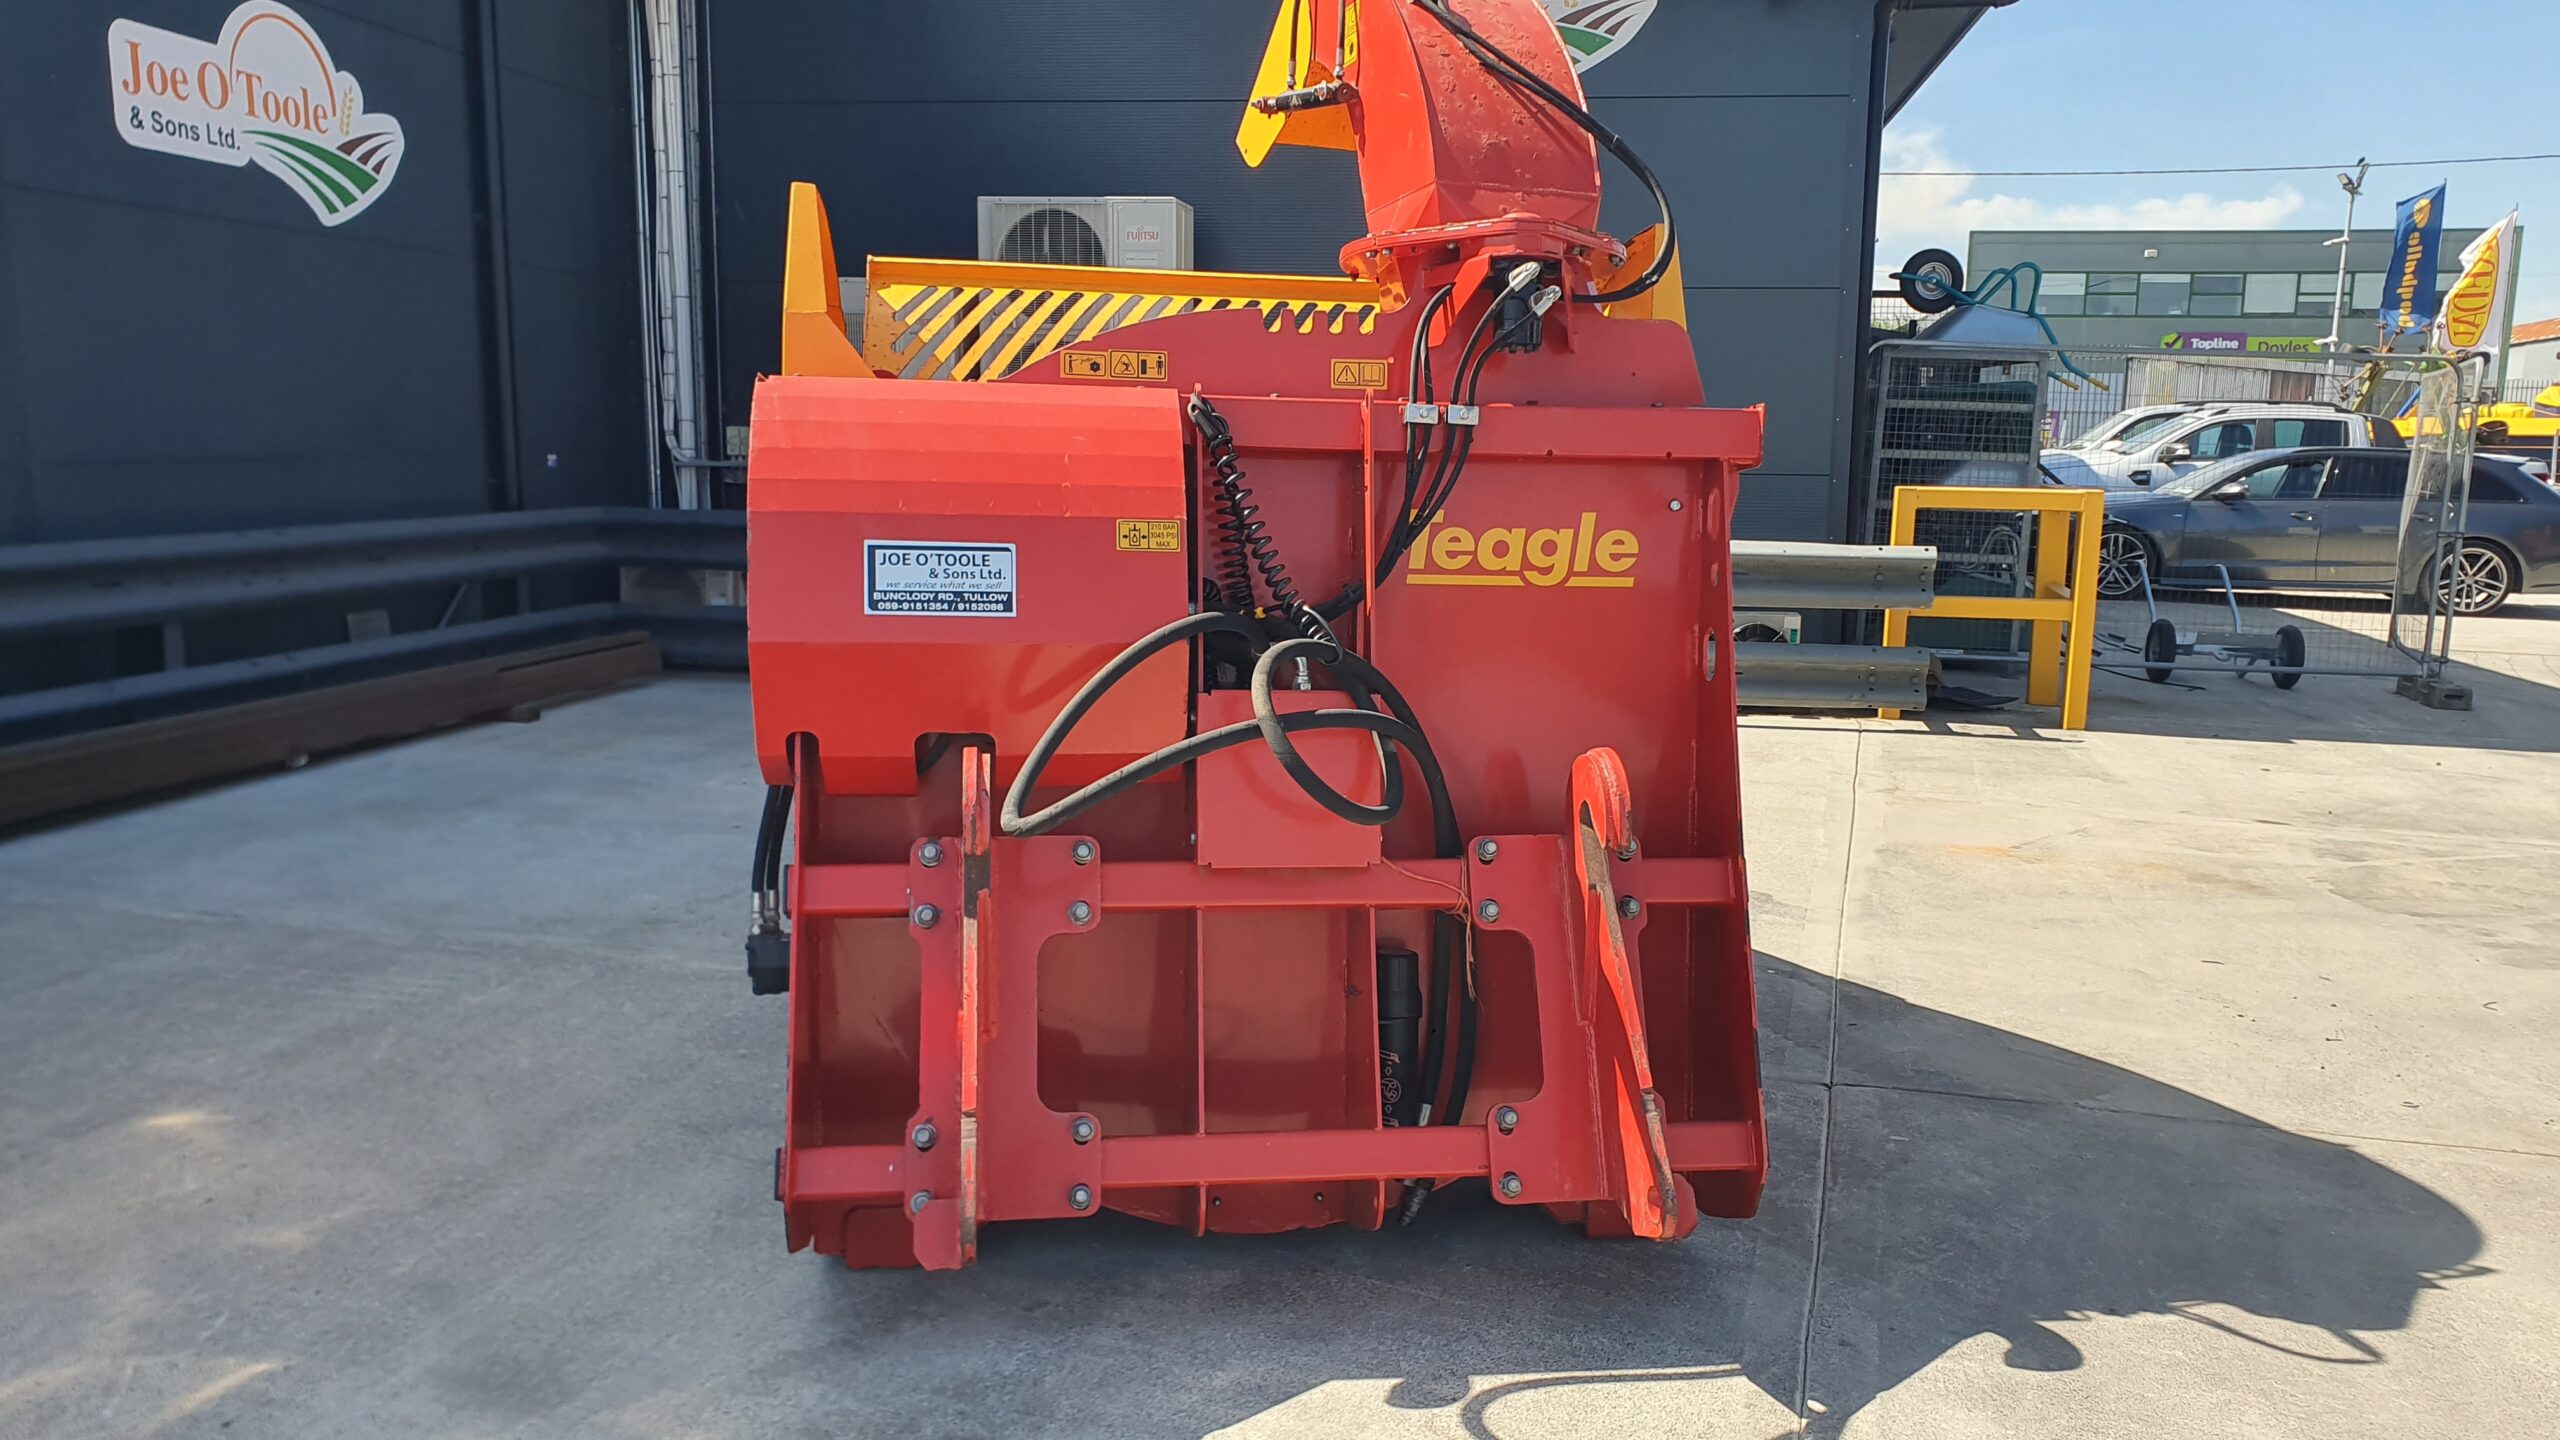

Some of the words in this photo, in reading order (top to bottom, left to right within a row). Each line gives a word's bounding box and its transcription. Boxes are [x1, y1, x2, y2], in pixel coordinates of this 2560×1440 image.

[121, 38, 190, 102] Joe
[129, 105, 145, 130] &
[151, 110, 201, 142] Sons
[206, 122, 241, 150] Ltd.
[1126, 227, 1159, 242] FUJITSU
[2190, 338, 2239, 350] Topline
[1408, 508, 1640, 587] Teagle
[879, 553, 911, 566] JOE
[916, 553, 991, 567] O'TOOLE
[928, 568, 939, 579] &
[943, 568, 976, 579] Sons
[979, 568, 1006, 580] Ltd.
[903, 580, 937, 589] service
[940, 581, 965, 589] what
[985, 581, 1003, 590] sell
[873, 592, 936, 601] BUNCLODY
[963, 593, 1008, 602] TULLOW
[877, 602, 949, 610] 059-9151354
